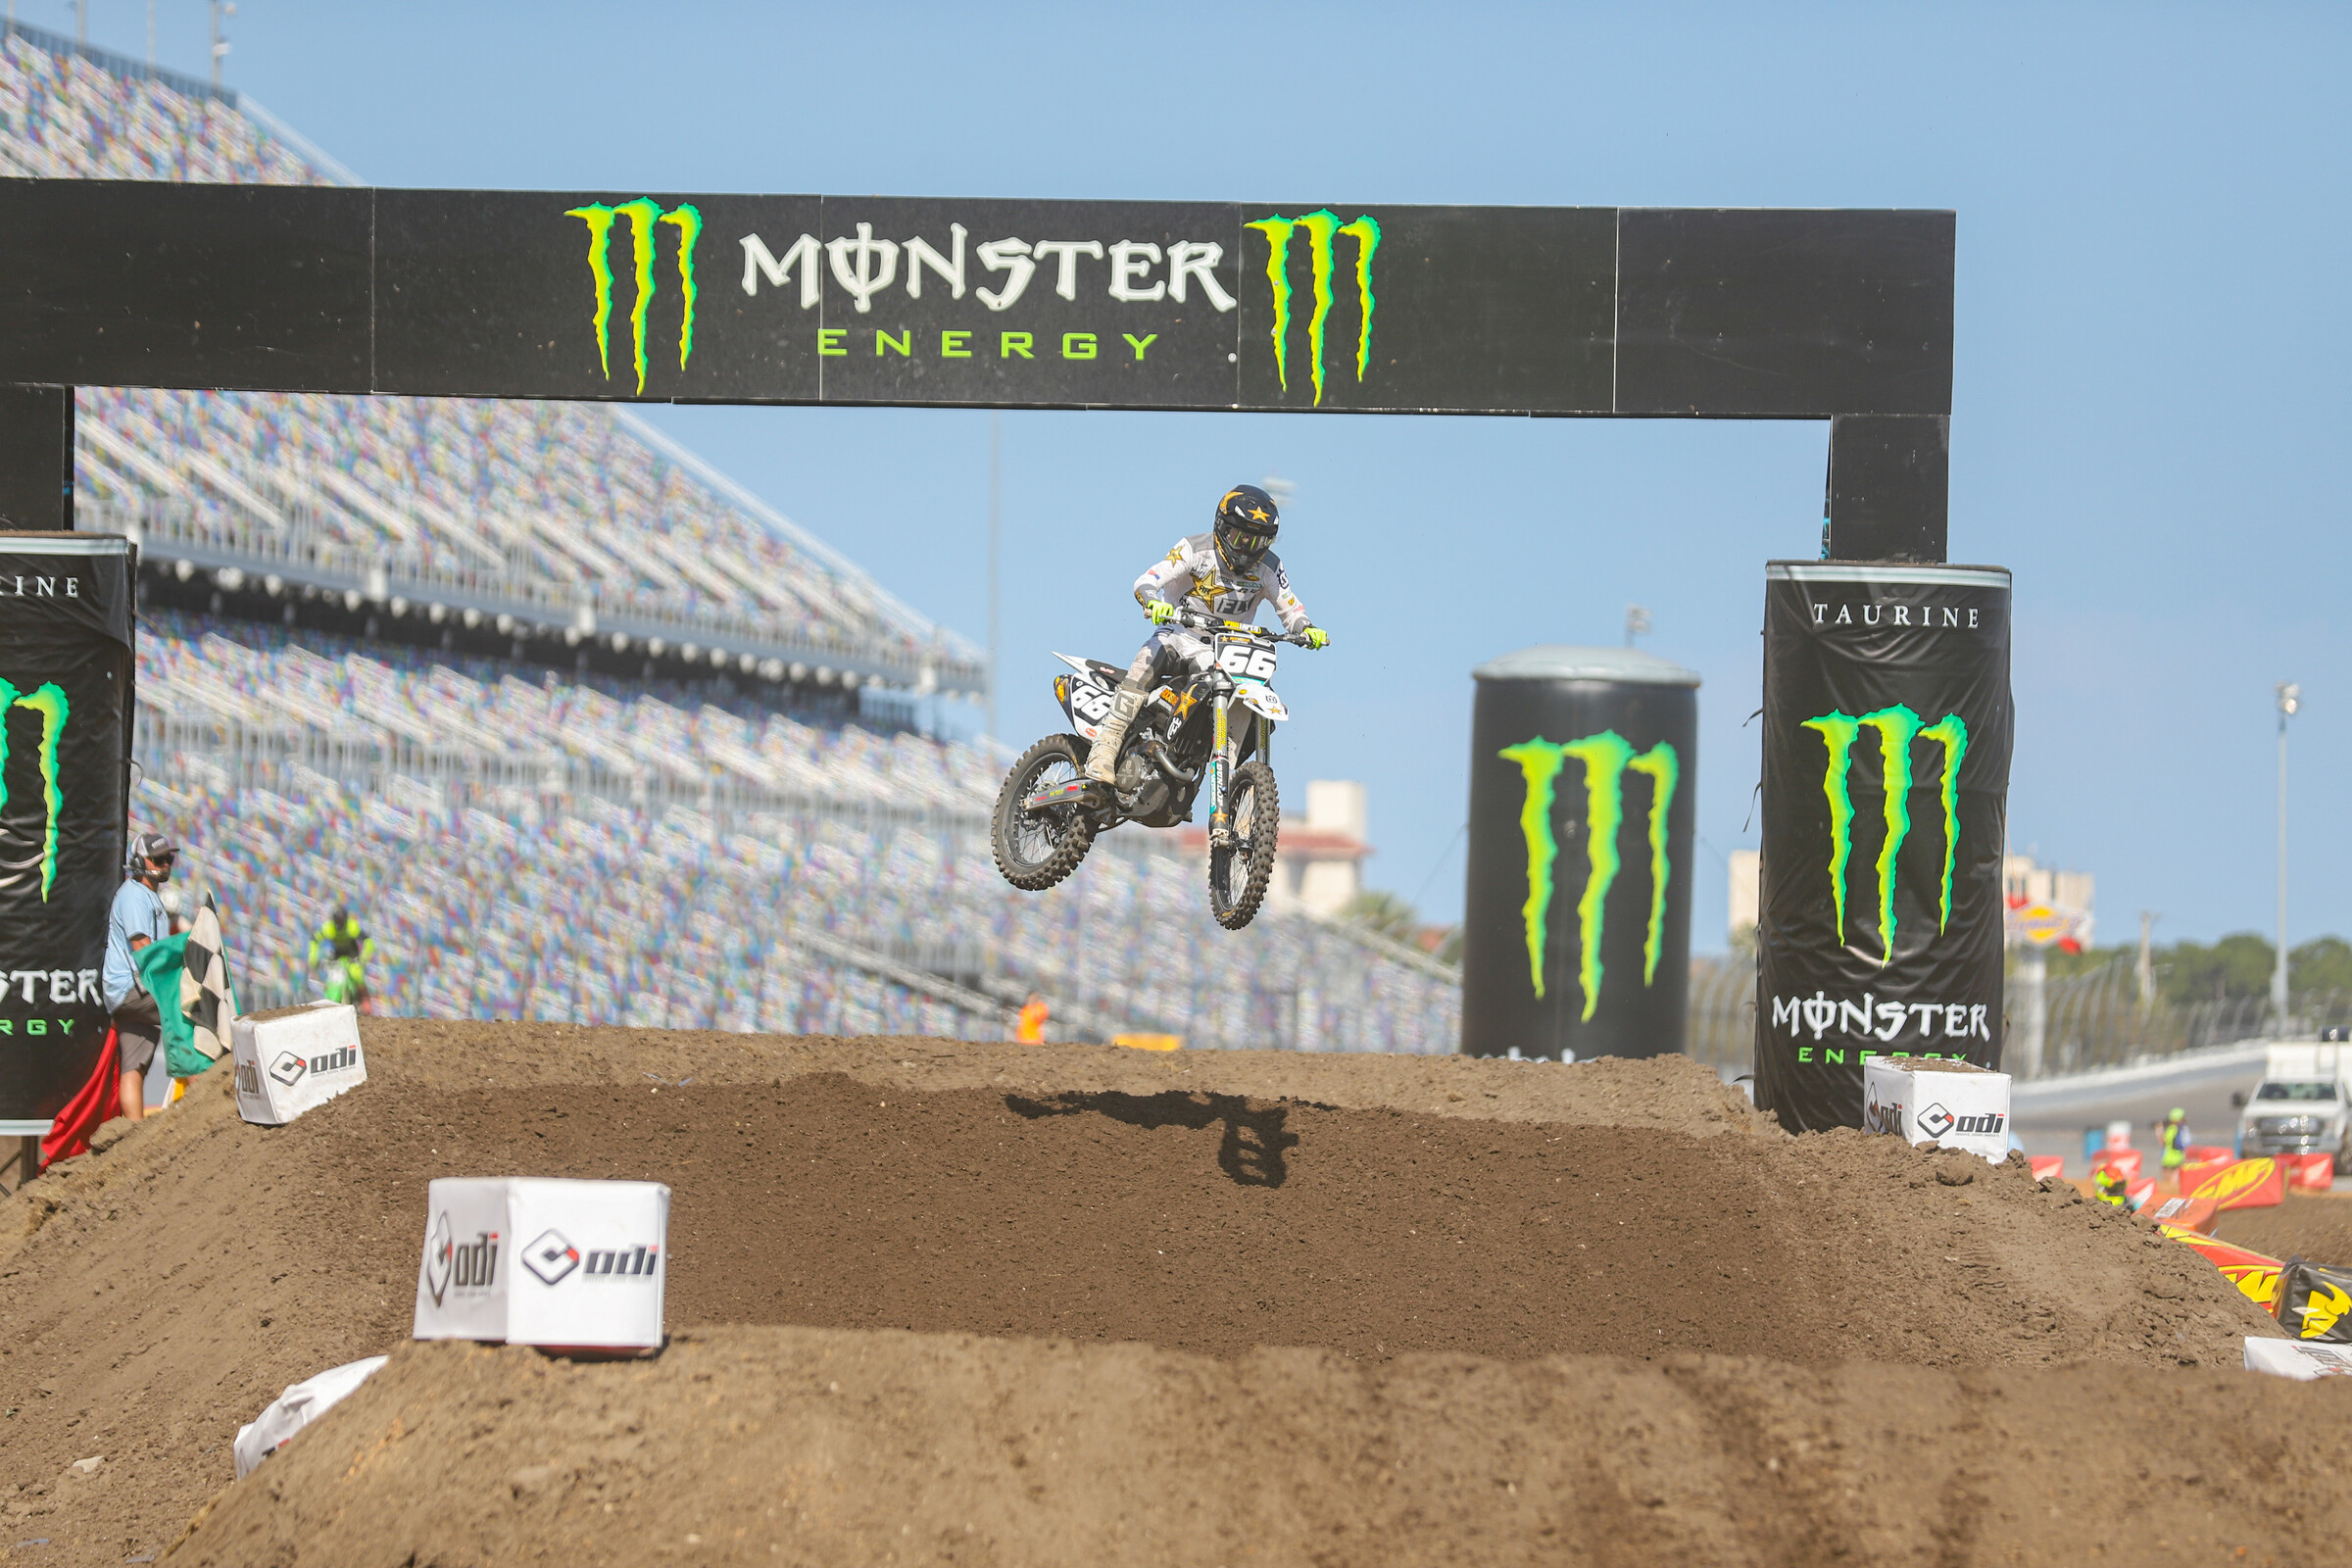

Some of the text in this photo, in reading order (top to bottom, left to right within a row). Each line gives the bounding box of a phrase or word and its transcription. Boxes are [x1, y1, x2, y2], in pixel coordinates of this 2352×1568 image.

[739, 221, 1238, 313] MONSTER
[817, 328, 1157, 361] ENERGY
[1814, 603, 1980, 629] TAURINE
[1218, 645, 1277, 679] 66
[1071, 685, 1111, 720] 66
[1772, 990, 1991, 1043] MONSTER
[310, 1045, 357, 1074] odi
[1956, 1113, 2004, 1133] odi
[454, 1232, 499, 1287] odi
[584, 1245, 659, 1275] odi
